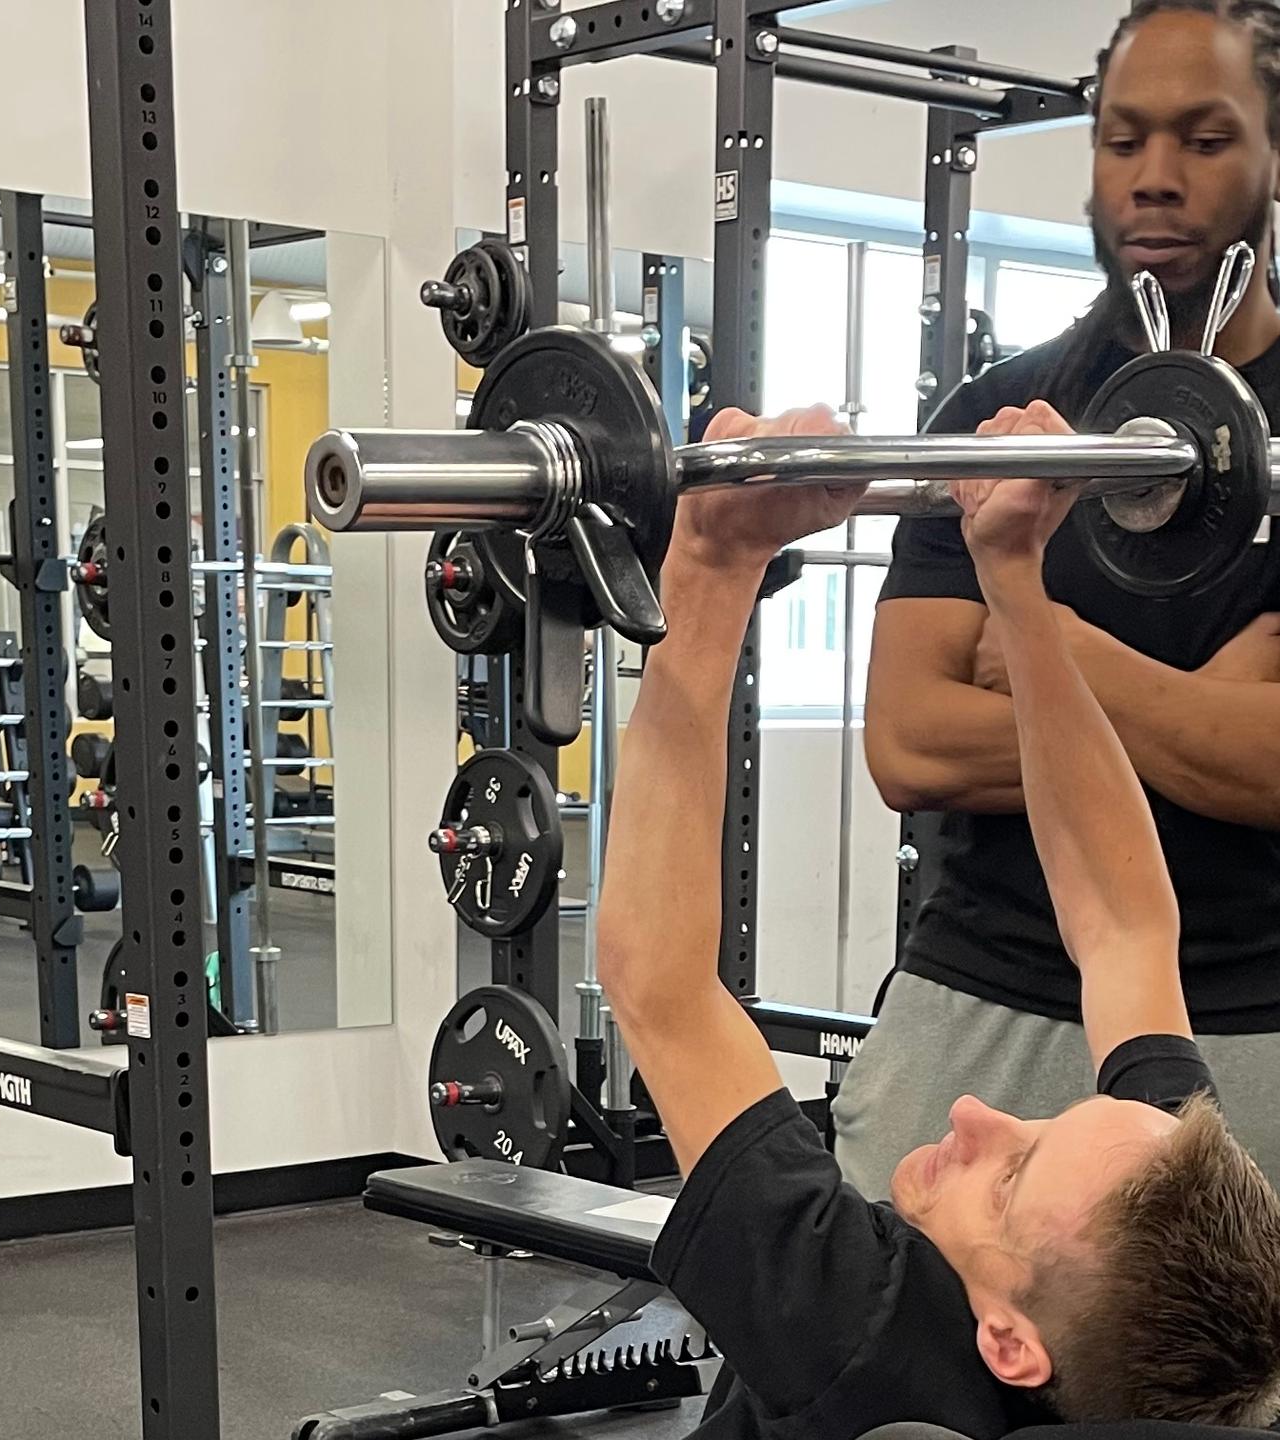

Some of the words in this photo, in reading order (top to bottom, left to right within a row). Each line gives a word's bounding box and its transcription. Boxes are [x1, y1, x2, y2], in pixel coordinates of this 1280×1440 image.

[138, 12, 153, 28] 14
[141, 109, 157, 124] 13
[716, 175, 735, 203] HS
[145, 204, 161, 220] 12
[149, 299, 163, 313] 11
[152, 391, 167, 404] 10
[158, 481, 167, 494] 9
[161, 571, 171, 583] 8
[164, 658, 173, 670] 7
[168, 744, 177, 756] 6
[485, 777, 501, 804] 35
[171, 828, 180, 841] 5
[174, 911, 183, 923] 4
[177, 993, 186, 1005] 3
[495, 1018, 531, 1065] UMAX
[820, 1031, 866, 1057] HAMM
[180, 1074, 189, 1086] 2
[493, 1130, 524, 1166] 20.4
[185, 1153, 191, 1164] 1
